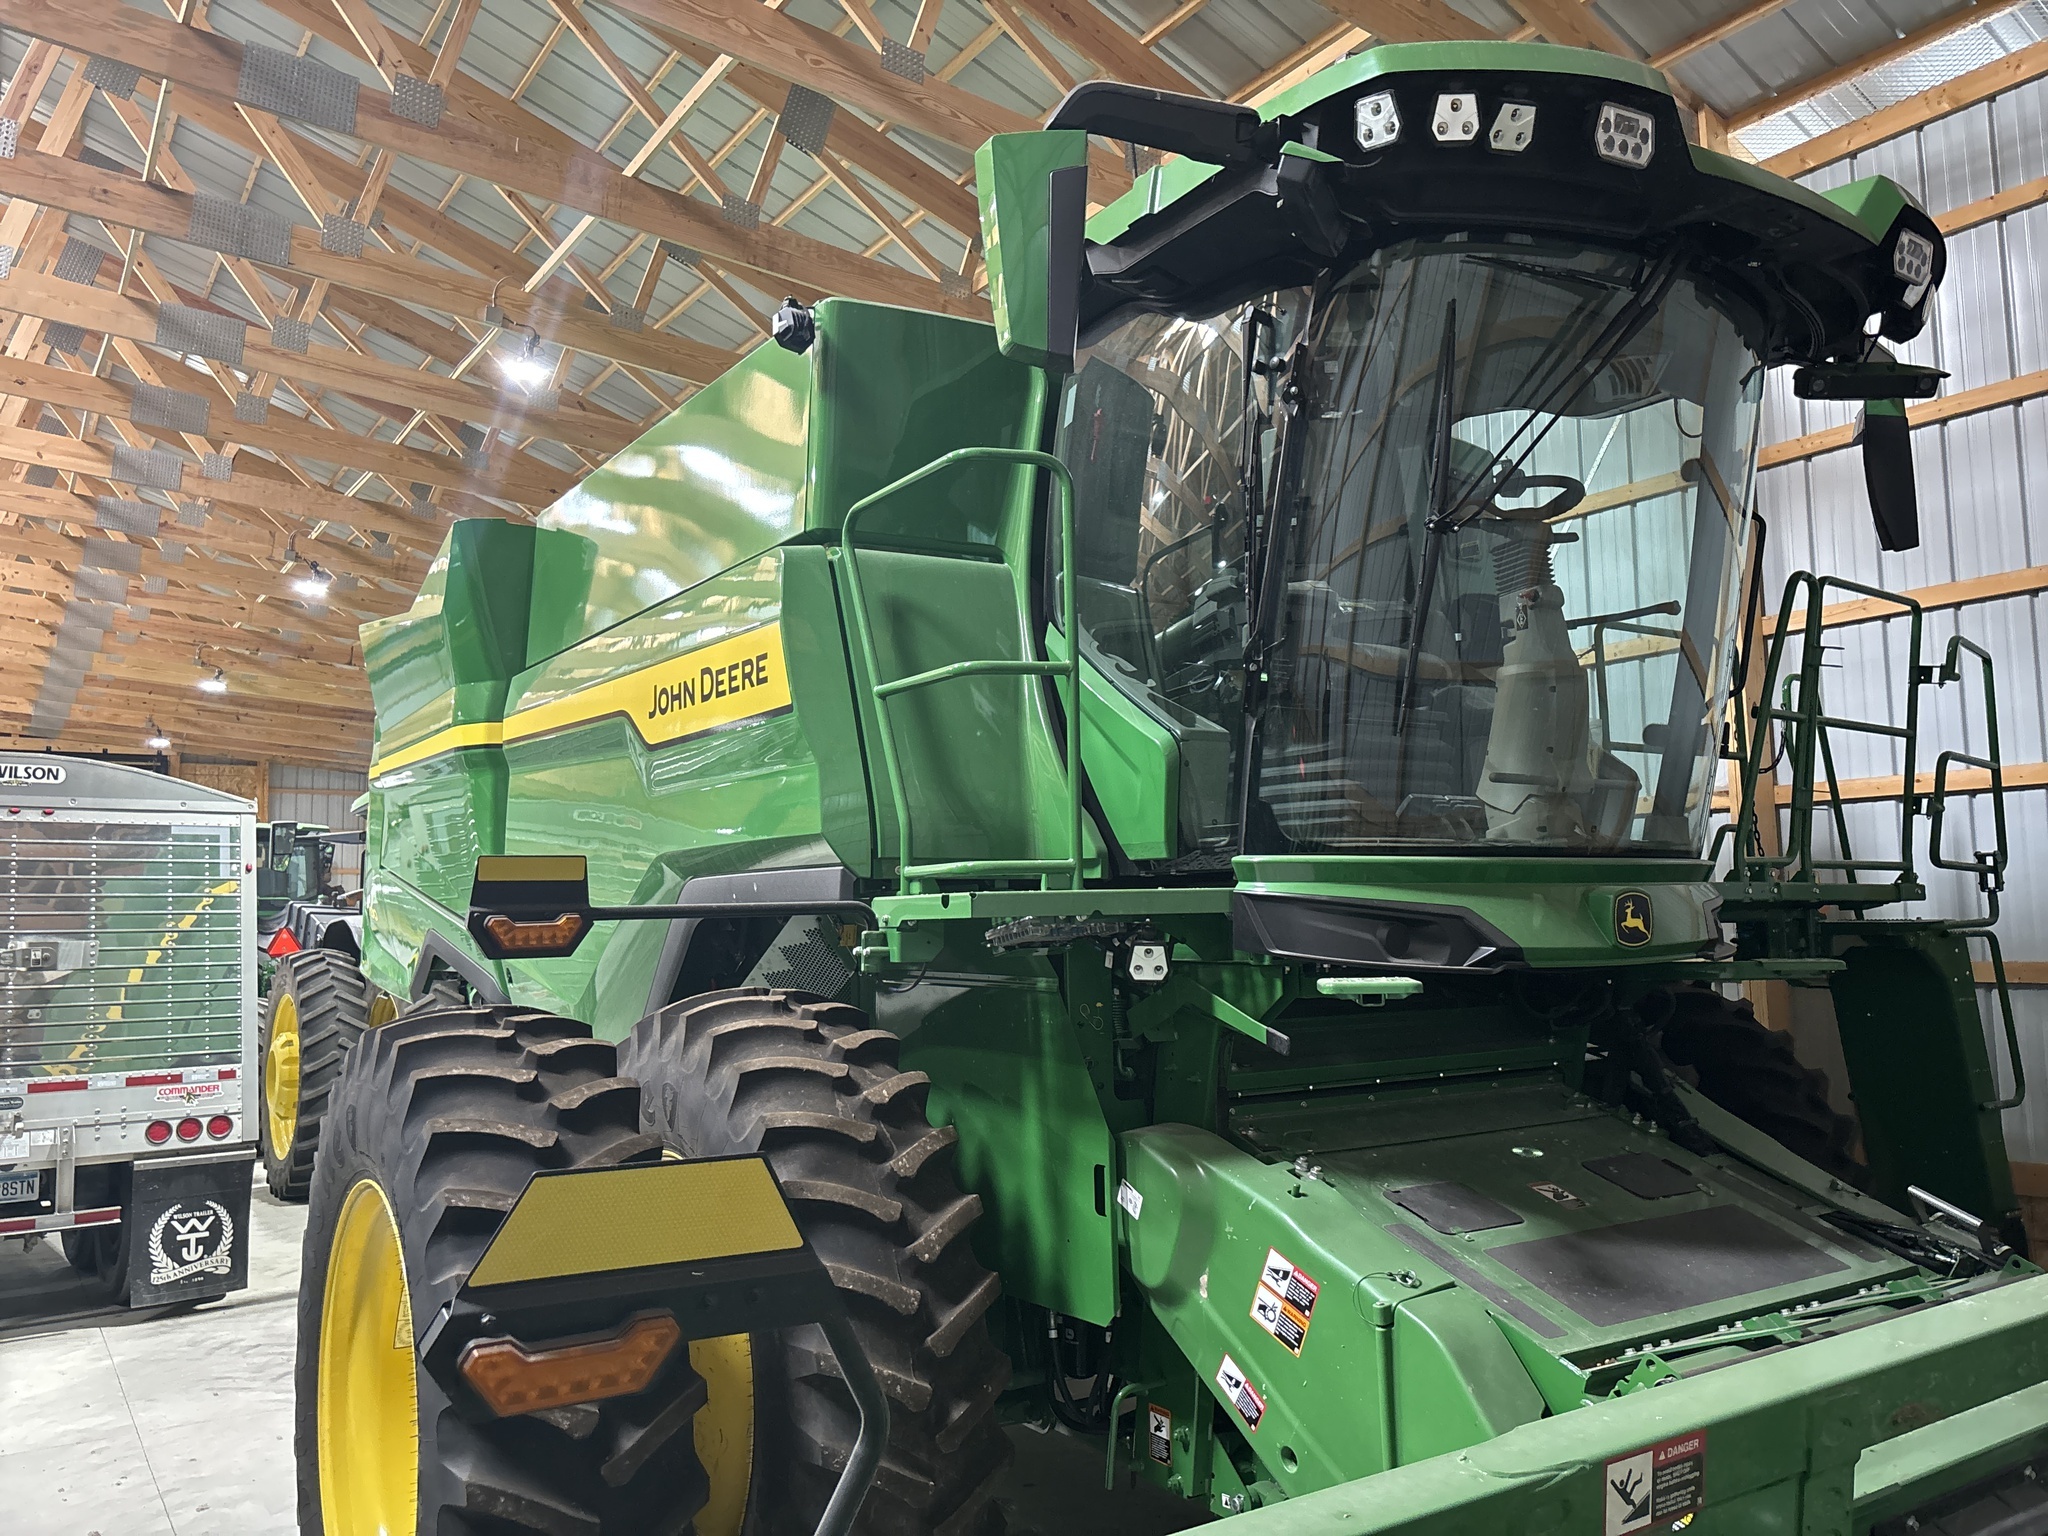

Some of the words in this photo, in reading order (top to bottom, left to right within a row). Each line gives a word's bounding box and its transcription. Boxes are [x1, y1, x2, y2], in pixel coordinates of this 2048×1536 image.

[648, 677, 695, 720] JOHN
[700, 652, 769, 703] DEERE
[158, 1084, 220, 1096] COMMANDER
[0, 1179, 35, 1197] 8STN
[1667, 1438, 1700, 1458] DANGER
